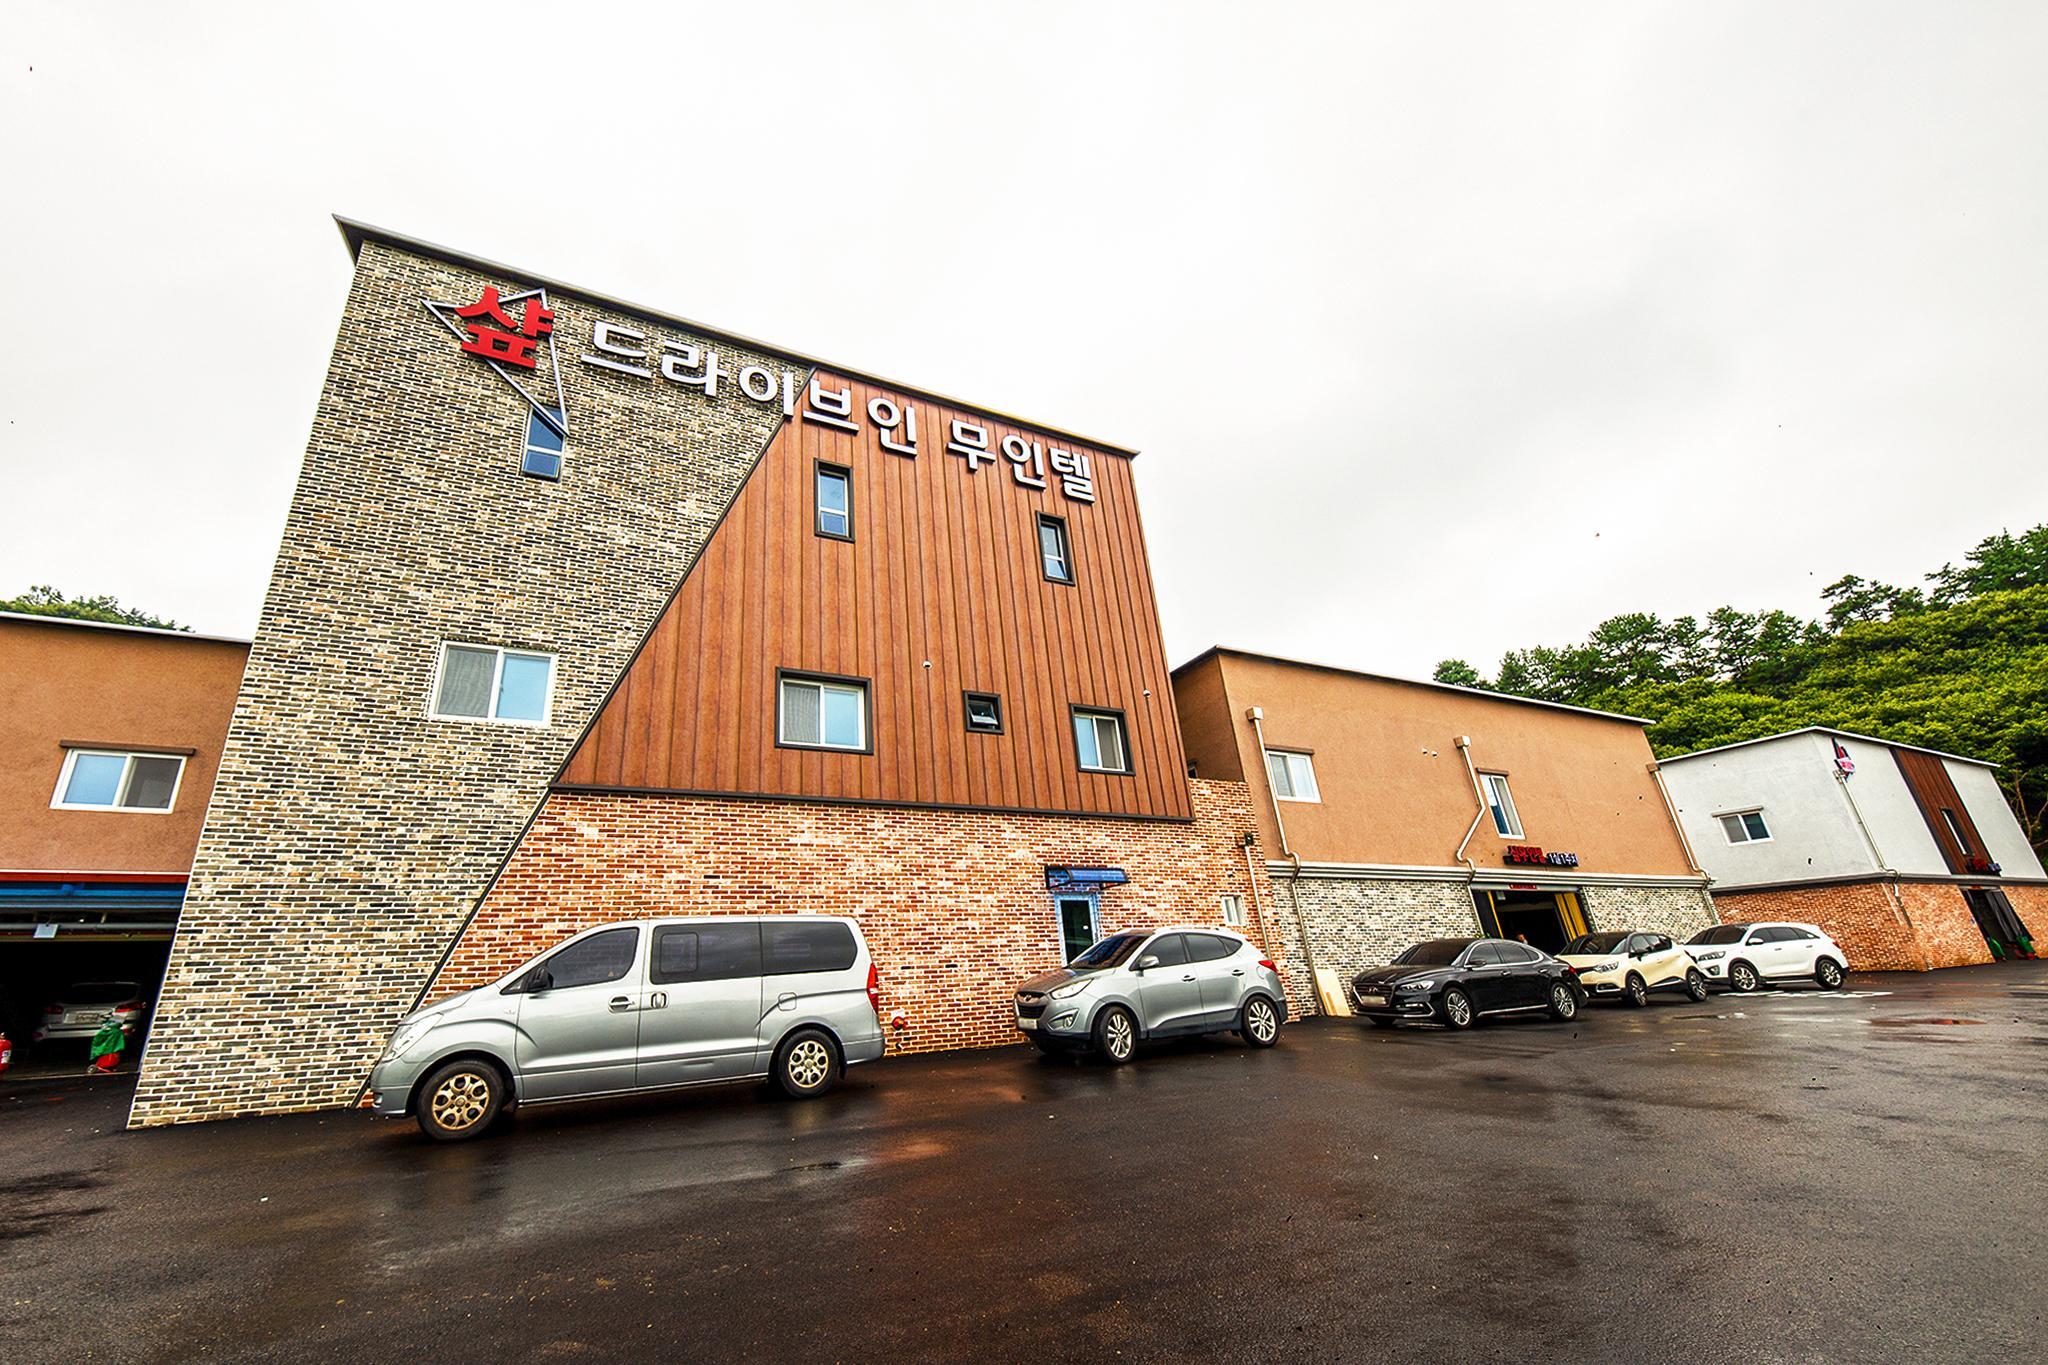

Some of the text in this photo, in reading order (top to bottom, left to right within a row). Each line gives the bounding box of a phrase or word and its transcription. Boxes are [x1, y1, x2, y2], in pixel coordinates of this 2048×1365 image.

[454, 285, 1096, 504] 샾 드라이브인 무인텔
